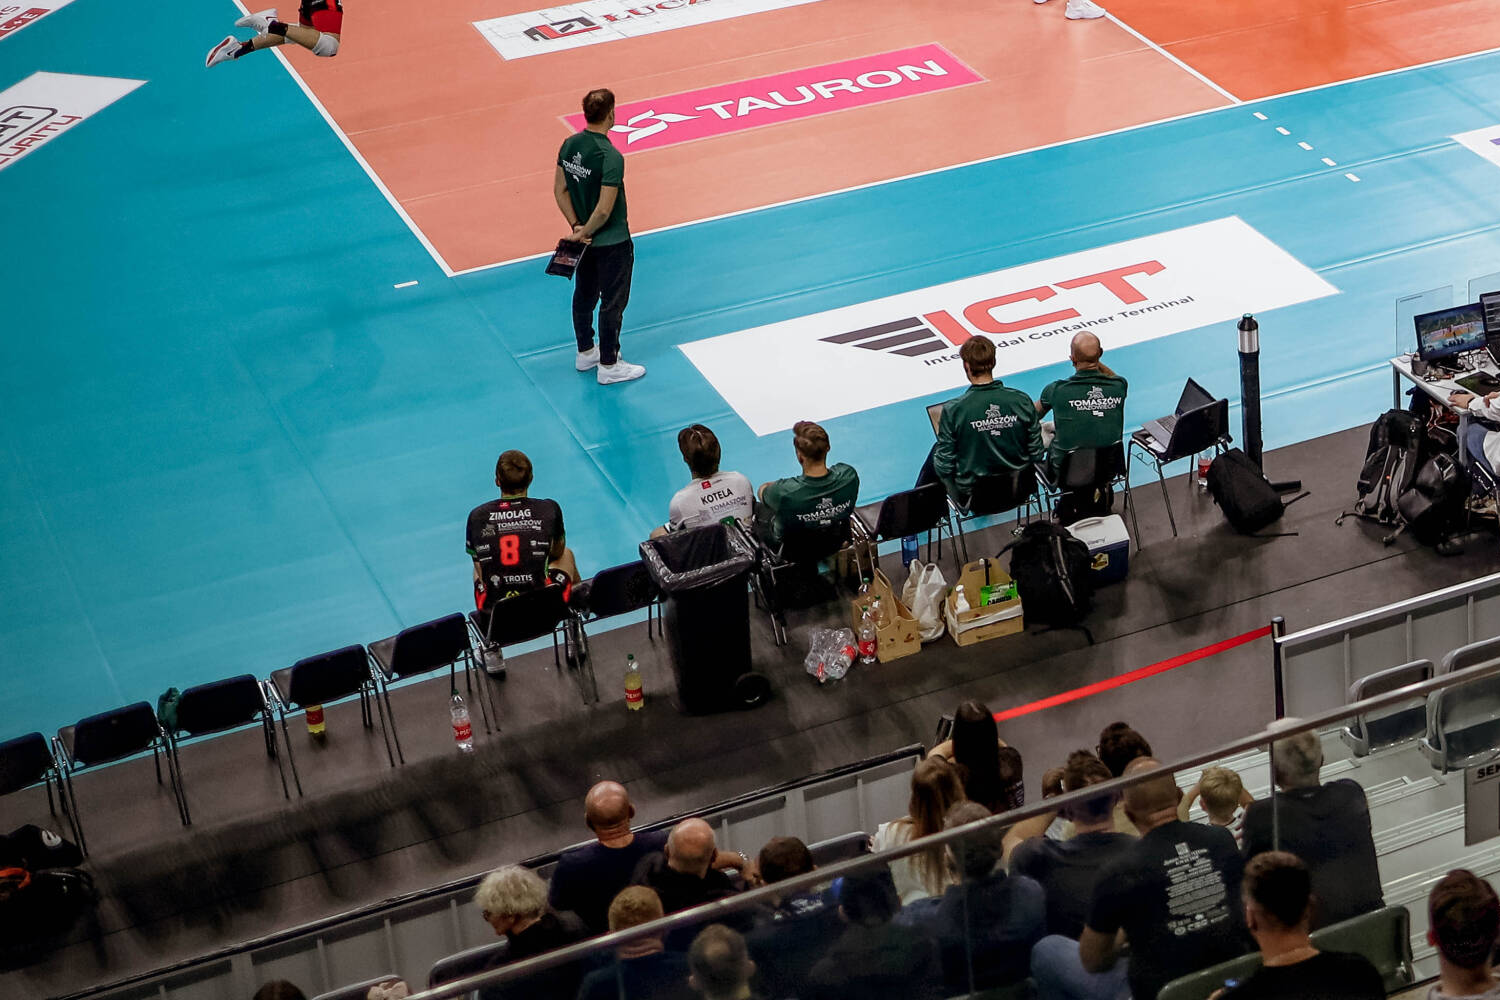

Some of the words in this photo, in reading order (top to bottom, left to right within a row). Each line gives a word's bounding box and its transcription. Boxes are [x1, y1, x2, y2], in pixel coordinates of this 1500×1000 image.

[695, 59, 949, 120] TAURON
[922, 259, 1167, 346] ICT
[1028, 314, 1116, 341] Container
[1117, 295, 1195, 320] Terminal
[1068, 395, 1122, 408] TOMASZÓW
[969, 413, 1018, 431] TOMASZÓW
[700, 487, 734, 505] KOTELA
[488, 508, 532, 521] ZIMOLĄG
[497, 519, 542, 529] TOMASZÓW
[499, 534, 520, 567] 8
[503, 574, 533, 583] TROTIS
